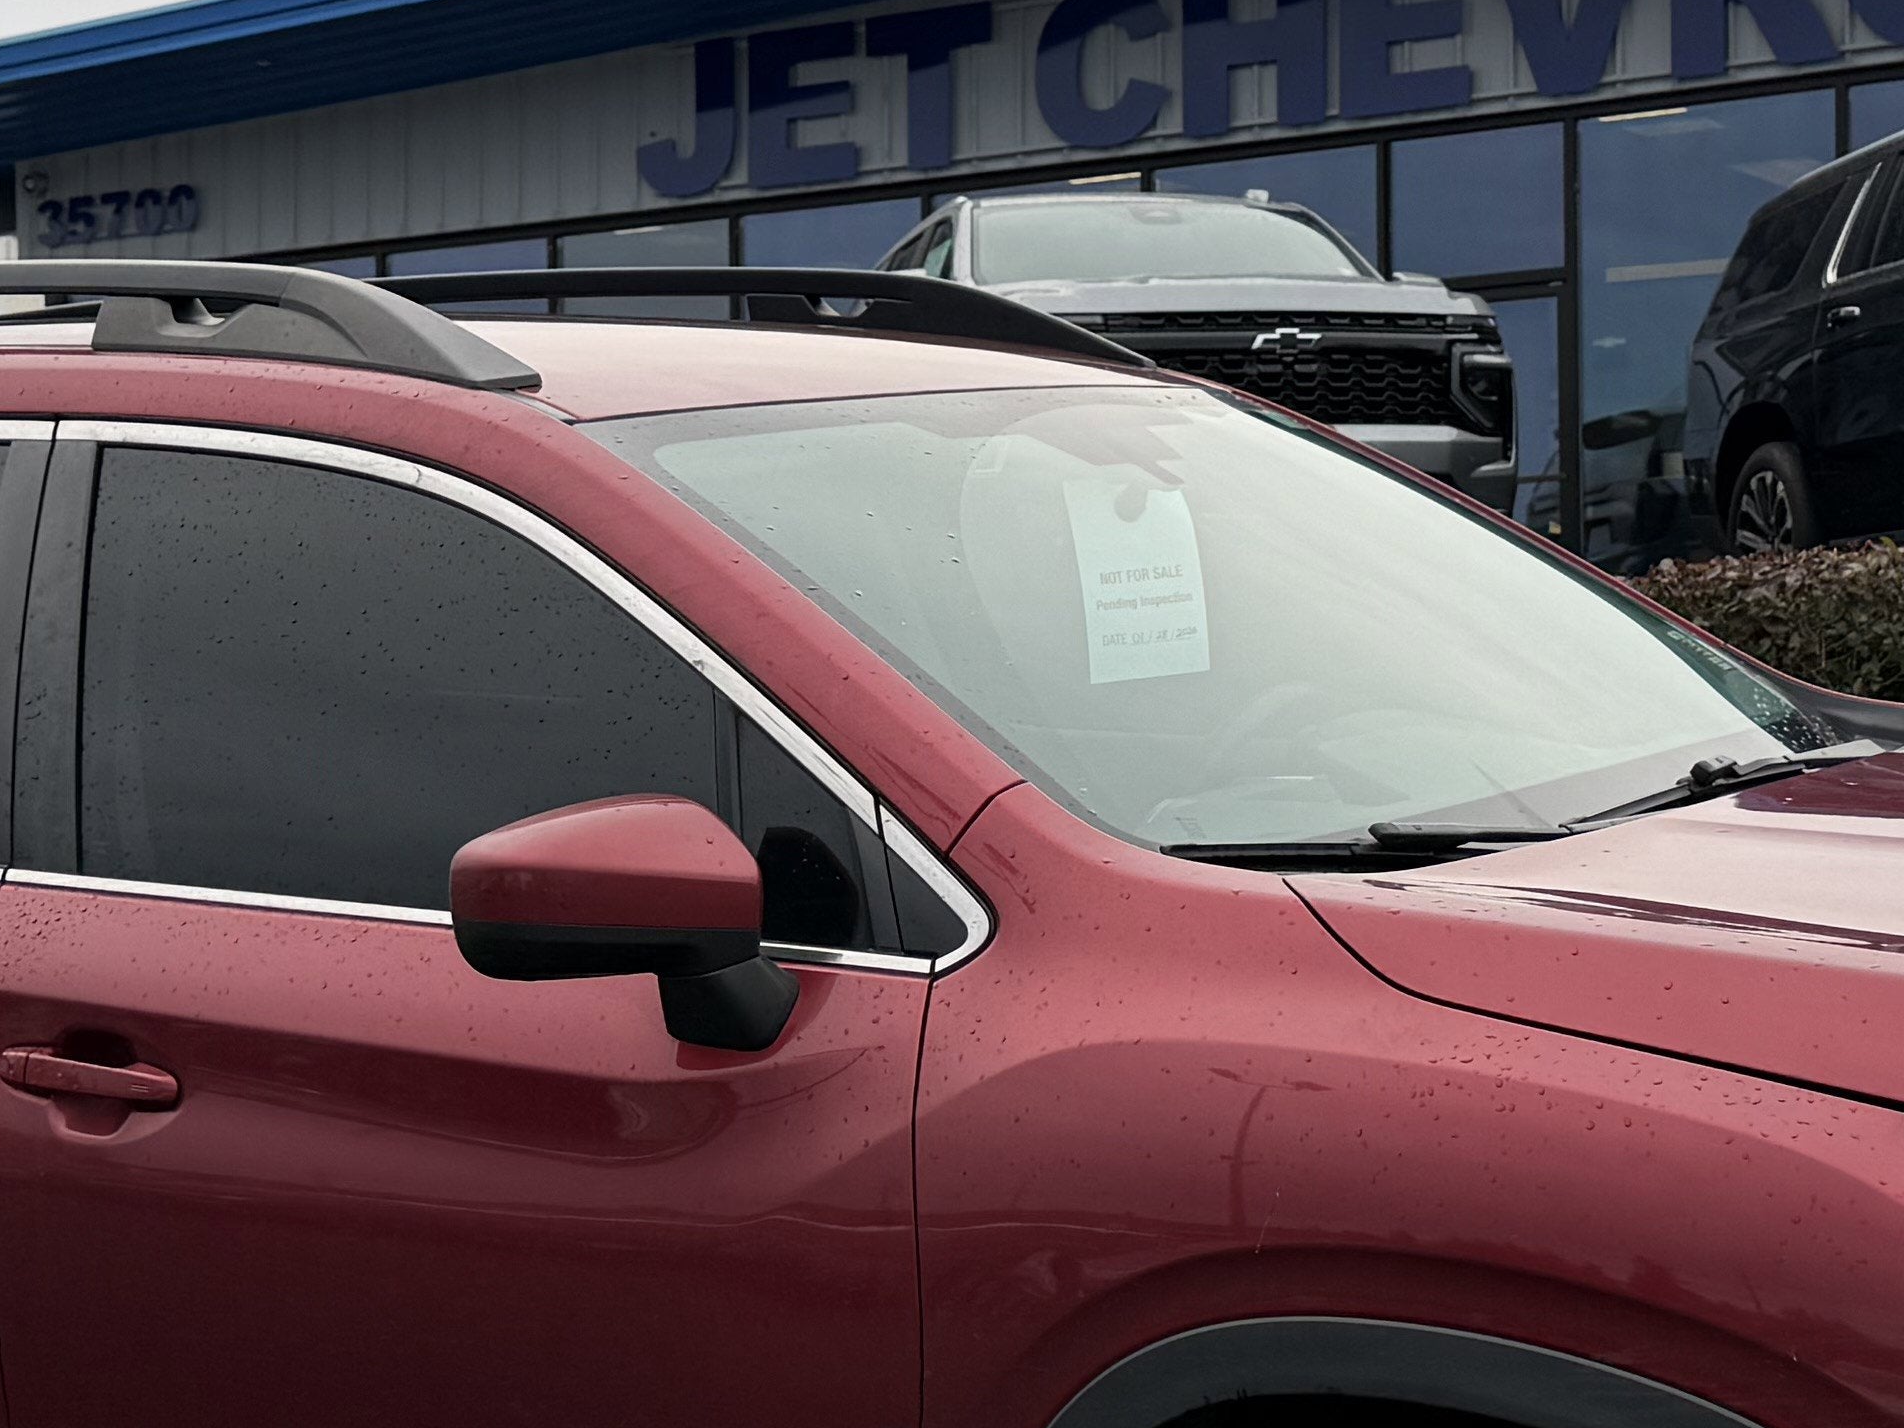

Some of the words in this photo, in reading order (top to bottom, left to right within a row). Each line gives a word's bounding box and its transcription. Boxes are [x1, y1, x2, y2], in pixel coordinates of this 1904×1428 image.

[637, 1, 992, 197] JET
[38, 184, 195, 249] 35700
[1099, 571, 1122, 584] NOT
[1126, 568, 1150, 582] FOR
[1152, 564, 1183, 579] SALE
[1096, 598, 1137, 610] Pending
[1139, 592, 1193, 607] Inspection
[1102, 633, 1127, 646] DATE
